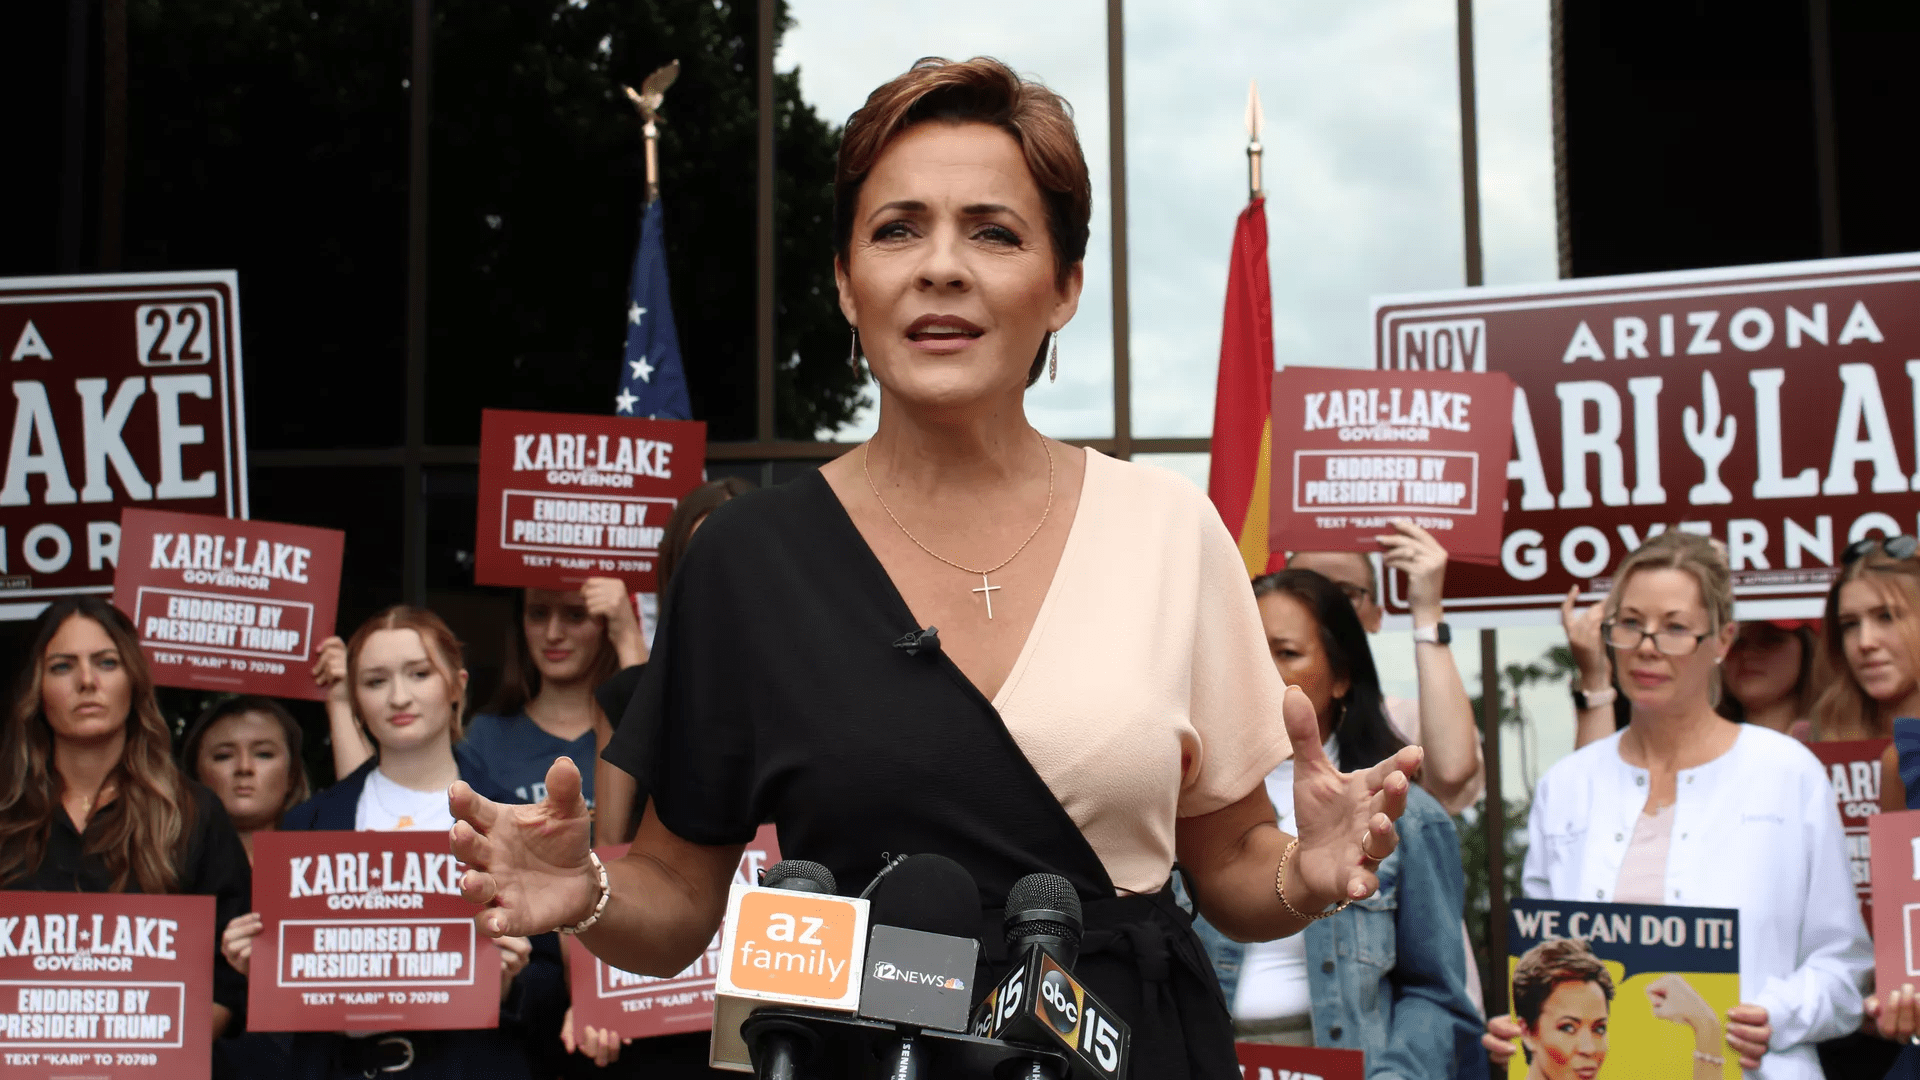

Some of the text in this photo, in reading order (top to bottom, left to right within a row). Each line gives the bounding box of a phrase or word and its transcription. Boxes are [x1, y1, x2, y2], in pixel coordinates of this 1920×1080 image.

[144, 307, 204, 363] 22
[1562, 301, 1884, 363] ARIZONA
[1404, 327, 1480, 372] NOV
[1304, 388, 1472, 432] KARI LAKE
[0, 374, 217, 507] AKE
[1338, 427, 1430, 441] GOVERNOR
[1504, 359, 1920, 511] ARI LA
[513, 433, 673, 479] KARI LAKE
[1326, 457, 1446, 480] ENDORSED BY
[546, 470, 634, 488] GOVERNOR
[1305, 480, 1466, 505] PRESIDENT TRUMP
[534, 498, 648, 526] ENDORSED BY
[0, 521, 121, 575] OR
[512, 519, 665, 549] PRESIDENT TRUMP
[150, 533, 311, 584] KARI LAKE
[522, 554, 552, 567] TEXT
[599, 559, 615, 571] TO
[183, 569, 270, 591] GOVERNOR
[167, 597, 283, 628] ENDORSED BY
[145, 616, 300, 652] PRESIDENT TRUMP
[153, 651, 184, 665] TEXT
[231, 659, 247, 671] TO
[1831, 759, 1882, 803] ARI
[289, 851, 465, 898] KARI LAKE
[327, 893, 424, 910] GOVERNOR
[0, 914, 178, 961] KARI LAKE
[313, 926, 441, 952] ENDORSED BY
[766, 912, 825, 946] az
[1513, 909, 1734, 950] WE CAN DO IT!
[33, 956, 133, 972] GOVERNOR
[291, 952, 463, 979] PRESIDENT TRUMP
[740, 941, 846, 983] family
[18, 988, 150, 1014] ENDORSED BY
[301, 993, 336, 1006] TEXT
[387, 992, 406, 1005] TO
[408, 991, 450, 1005] 70789
[621, 997, 654, 1013] TEXT
[995, 965, 1025, 1032] 15
[0, 1014, 172, 1040] PRESIDENT TRUMP
[1041, 980, 1119, 1073] abc 15
[4, 1053, 41, 1066] TEXT
[94, 1053, 113, 1066] TO
[116, 1053, 158, 1067] 70789
